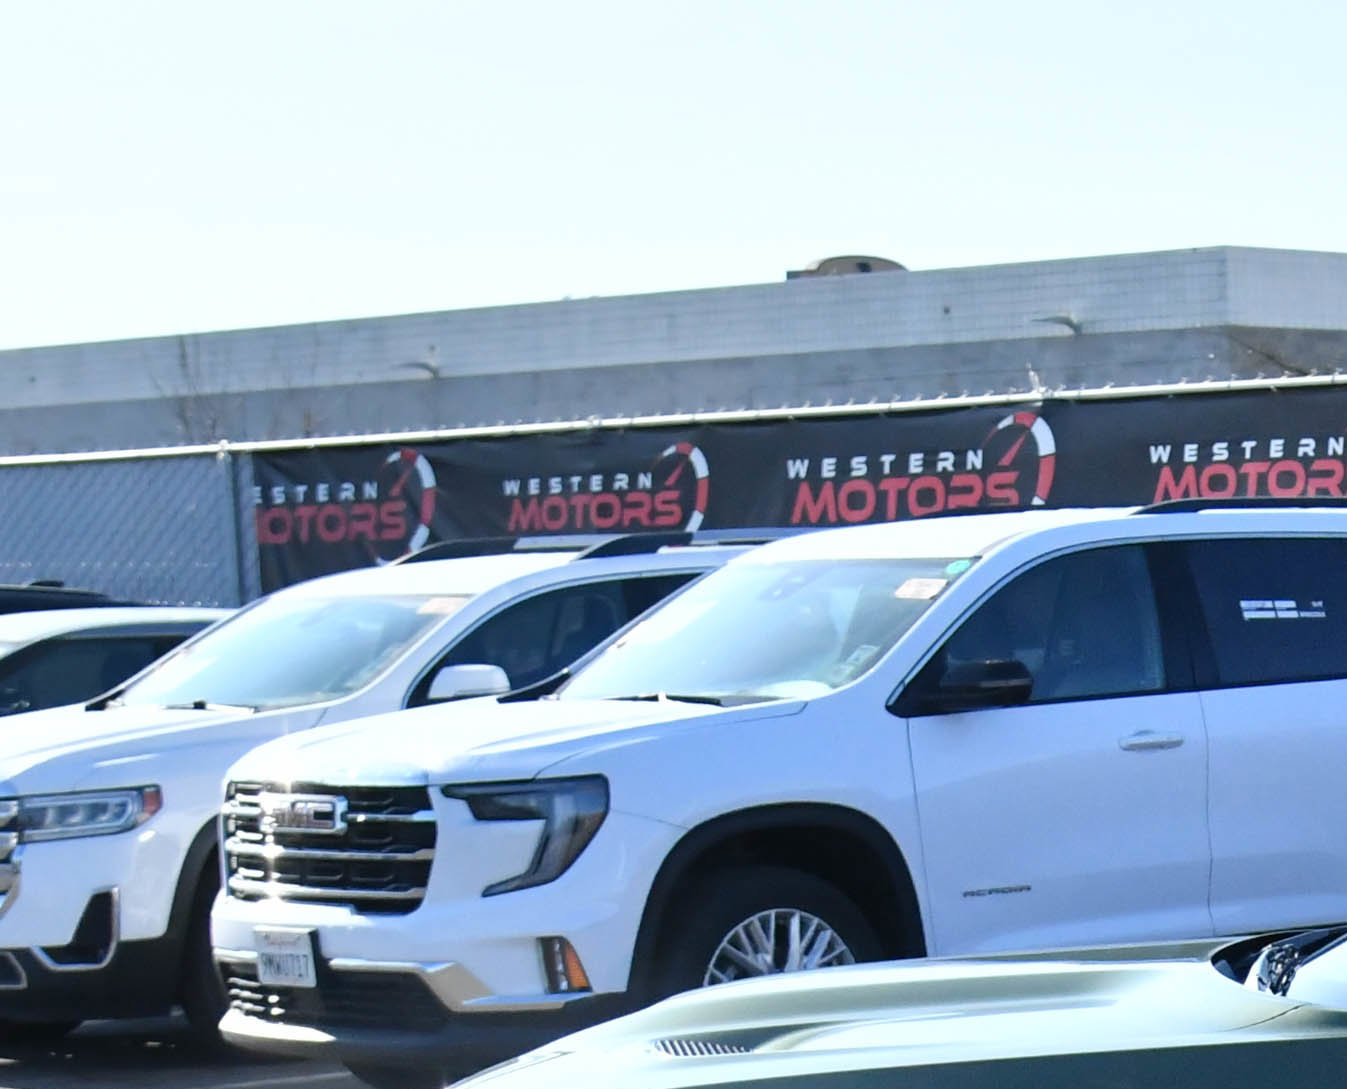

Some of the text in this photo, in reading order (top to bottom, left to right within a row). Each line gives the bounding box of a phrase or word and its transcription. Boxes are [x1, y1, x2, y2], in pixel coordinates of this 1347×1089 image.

[786, 449, 984, 480] WESTERN
[1149, 435, 1345, 464] WESTERN
[503, 472, 653, 496] WESTERN
[788, 471, 1020, 525] MOTORS
[256, 501, 407, 544] OTORS
[508, 490, 683, 532] MOTORS
